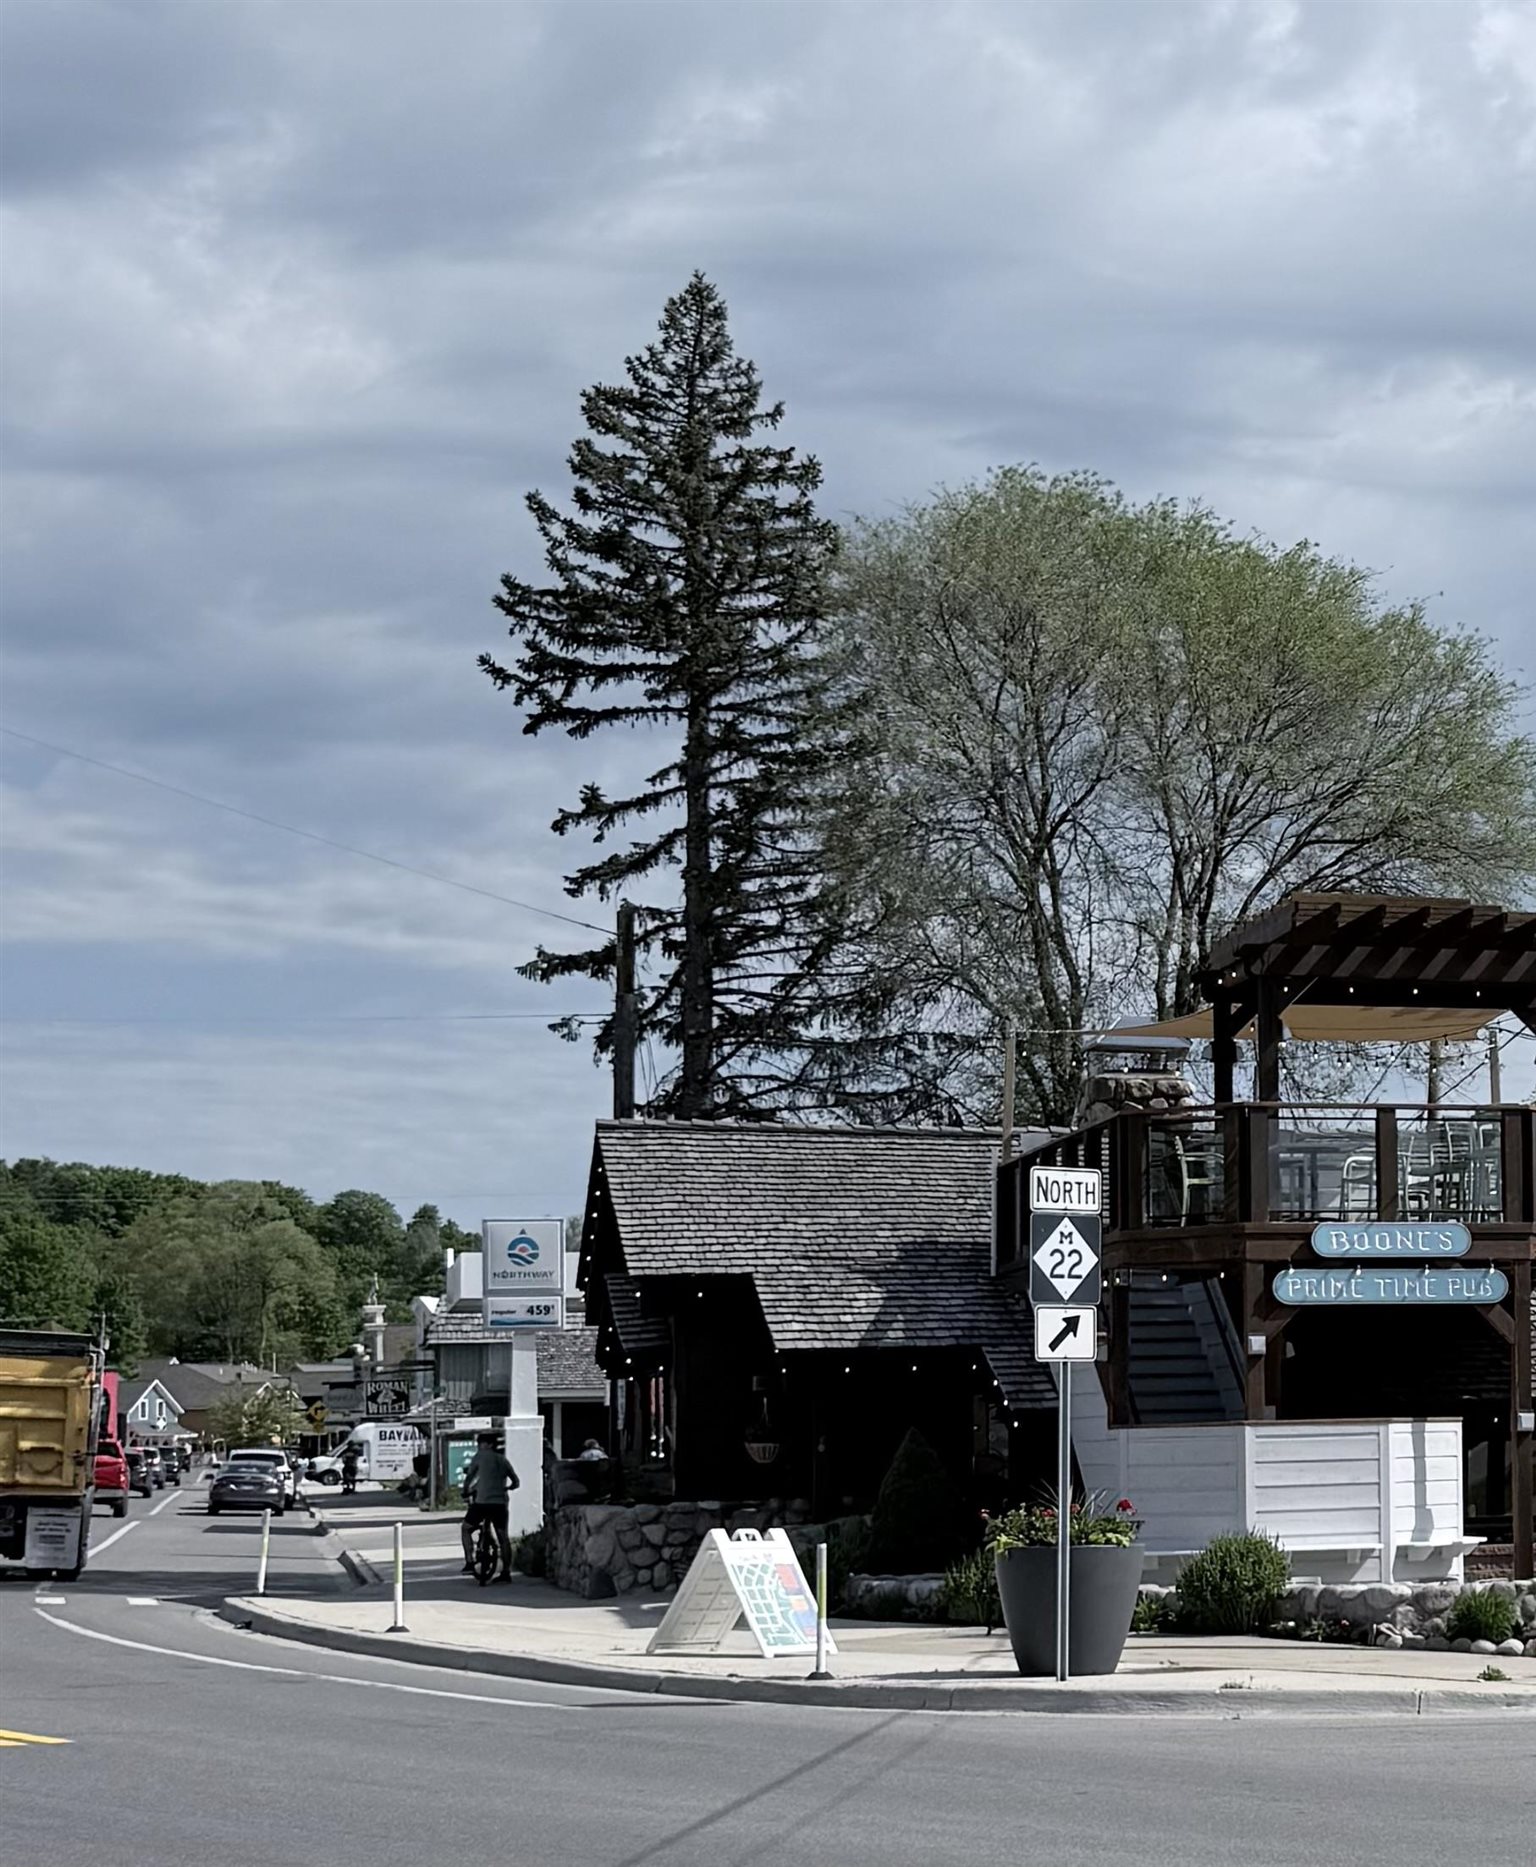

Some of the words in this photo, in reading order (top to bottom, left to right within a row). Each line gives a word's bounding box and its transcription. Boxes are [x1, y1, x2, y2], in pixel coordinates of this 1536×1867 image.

[1036, 1175, 1096, 1205] NORTH
[1059, 1231, 1074, 1245] M
[1329, 1230, 1453, 1251] BOONE'S
[1049, 1248, 1083, 1279] 22
[493, 1270, 555, 1280] NORTHWAY
[1286, 1277, 1364, 1298] PRIME
[1374, 1278, 1437, 1298] TIME
[1447, 1277, 1494, 1297] PUB
[367, 1381, 409, 1396] ROMAN
